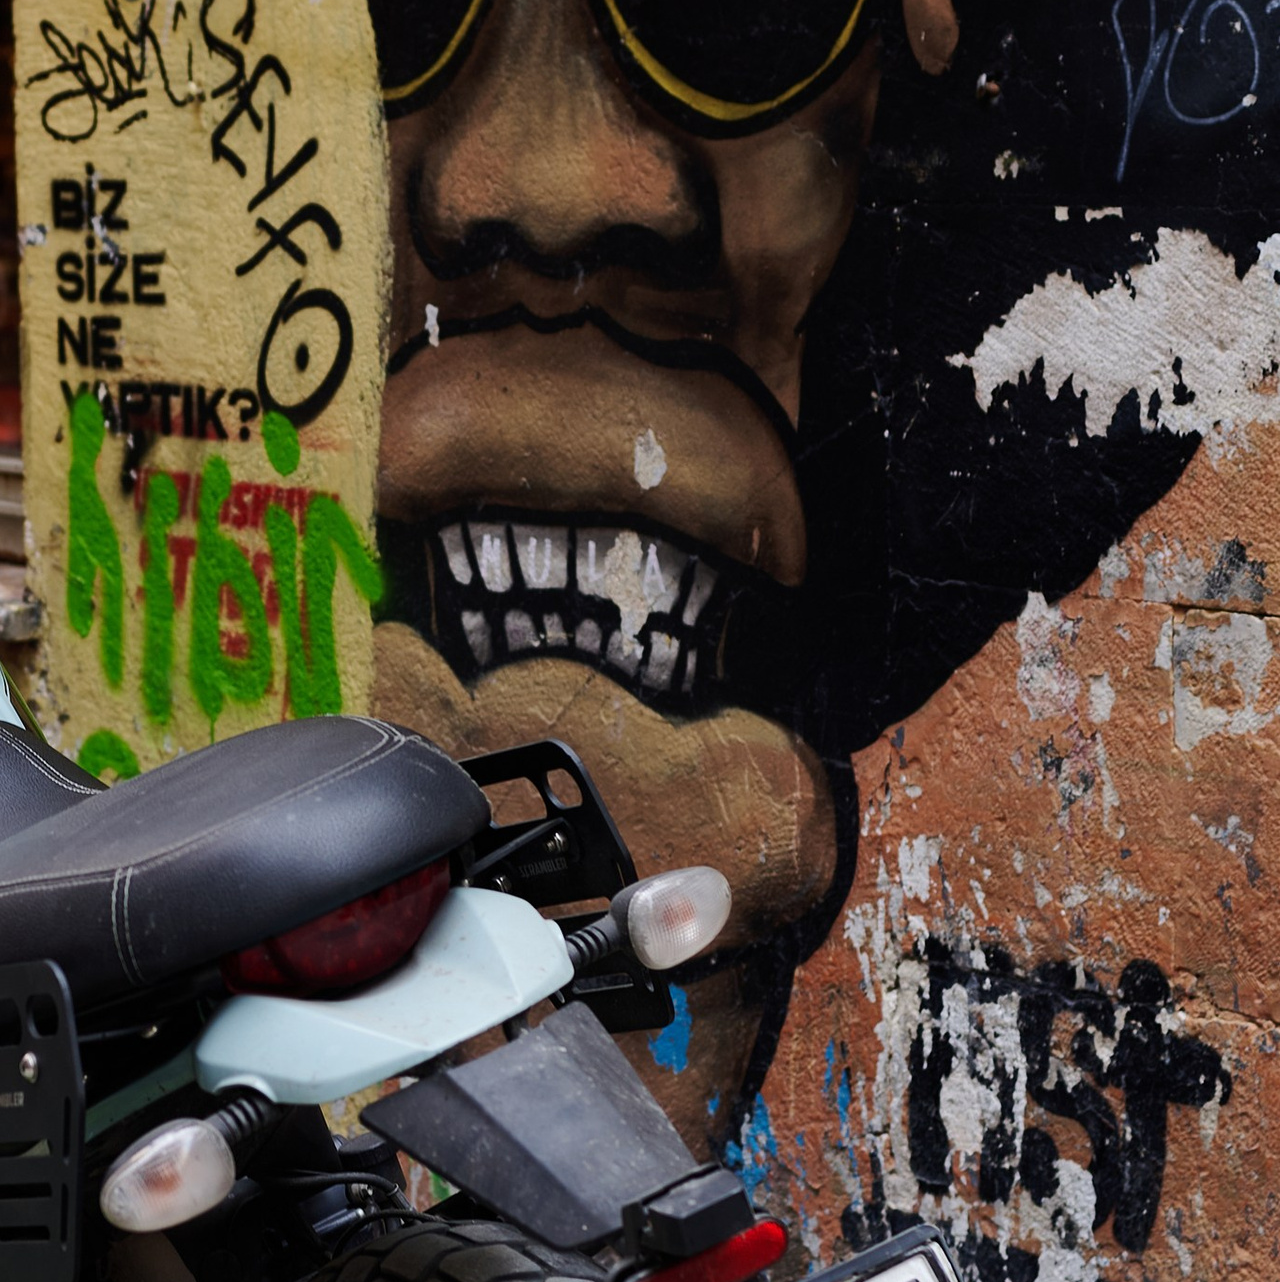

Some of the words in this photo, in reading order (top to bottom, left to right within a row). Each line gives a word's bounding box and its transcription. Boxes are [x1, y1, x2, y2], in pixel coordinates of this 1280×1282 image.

[51, 162, 128, 230] BİZ
[56, 234, 166, 305] SİZE
[58, 316, 123, 369] NE
